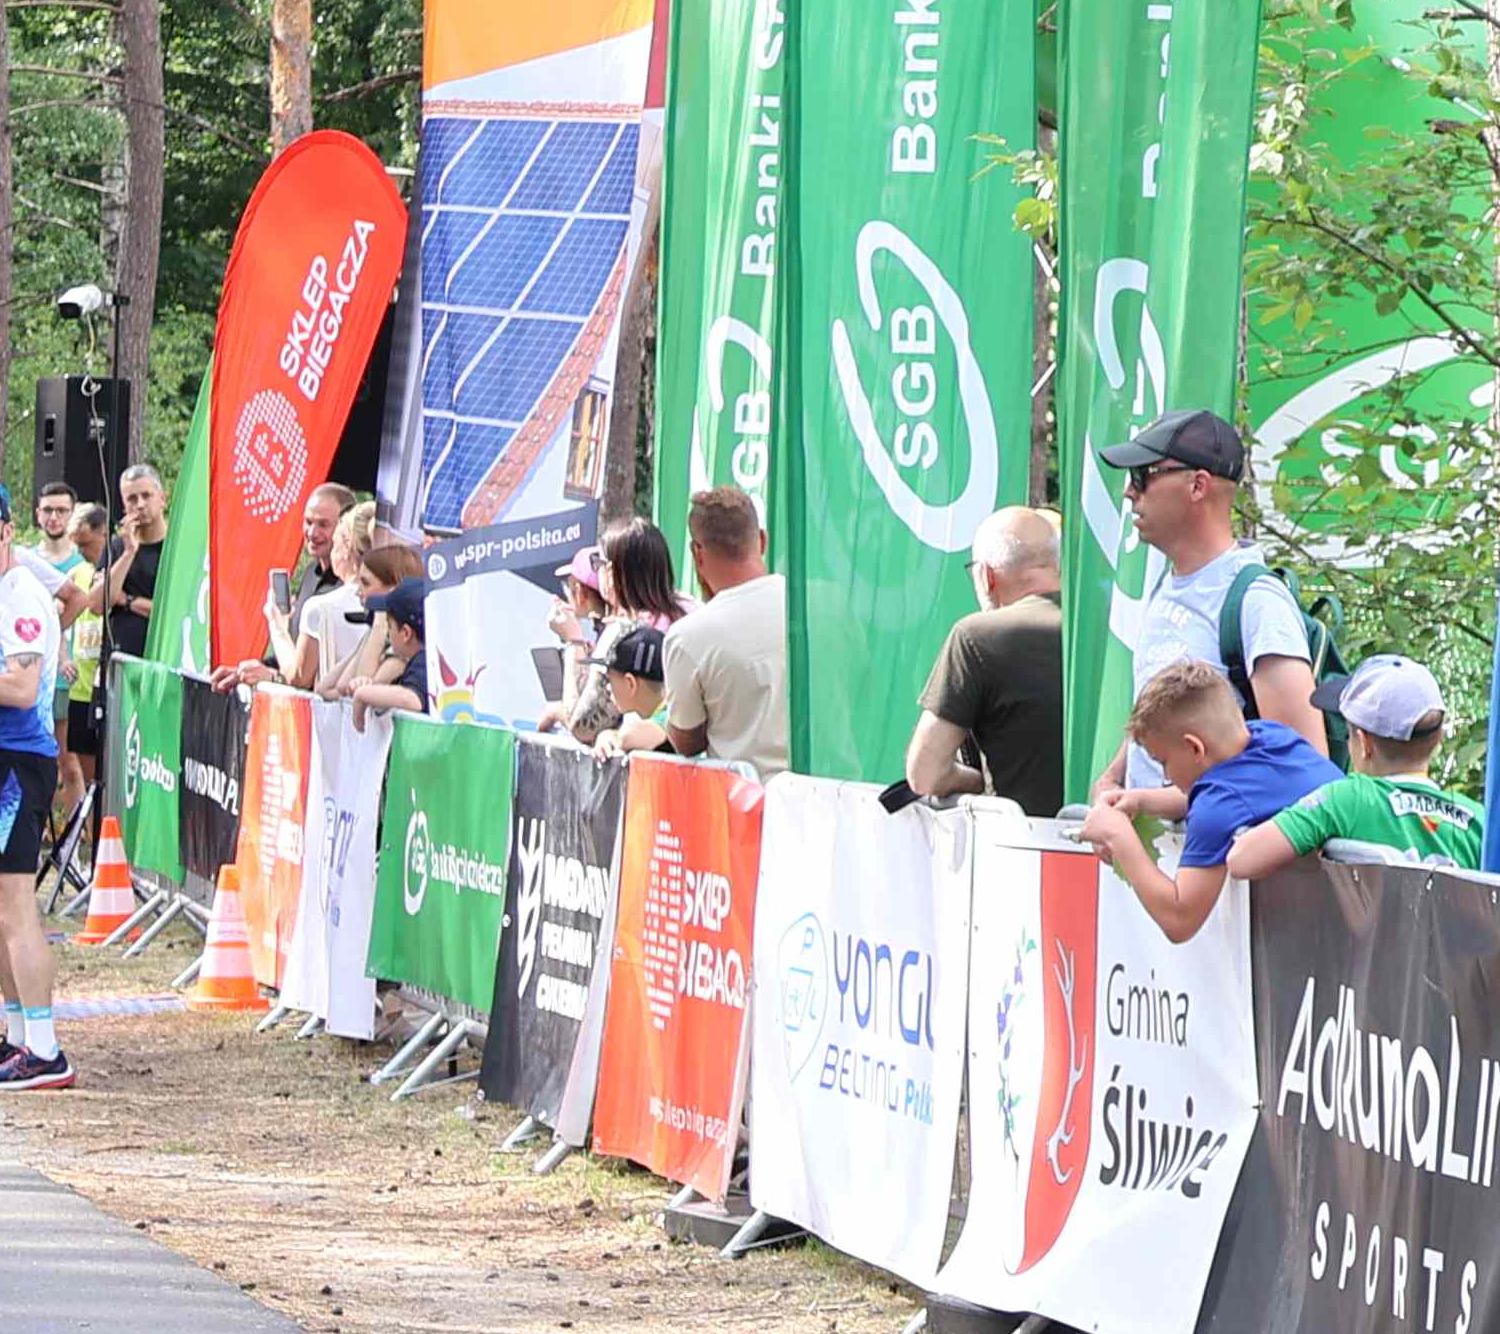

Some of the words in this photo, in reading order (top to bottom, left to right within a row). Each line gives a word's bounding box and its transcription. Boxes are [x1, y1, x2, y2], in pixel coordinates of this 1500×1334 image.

[741, 93, 781, 277] Banki
[280, 255, 329, 378] SKLEP
[299, 219, 375, 401] BIEGACZA
[891, 304, 937, 469] SGB
[1106, 963, 1189, 1048] Gmina
[1099, 1064, 1228, 1200] Śliwice
